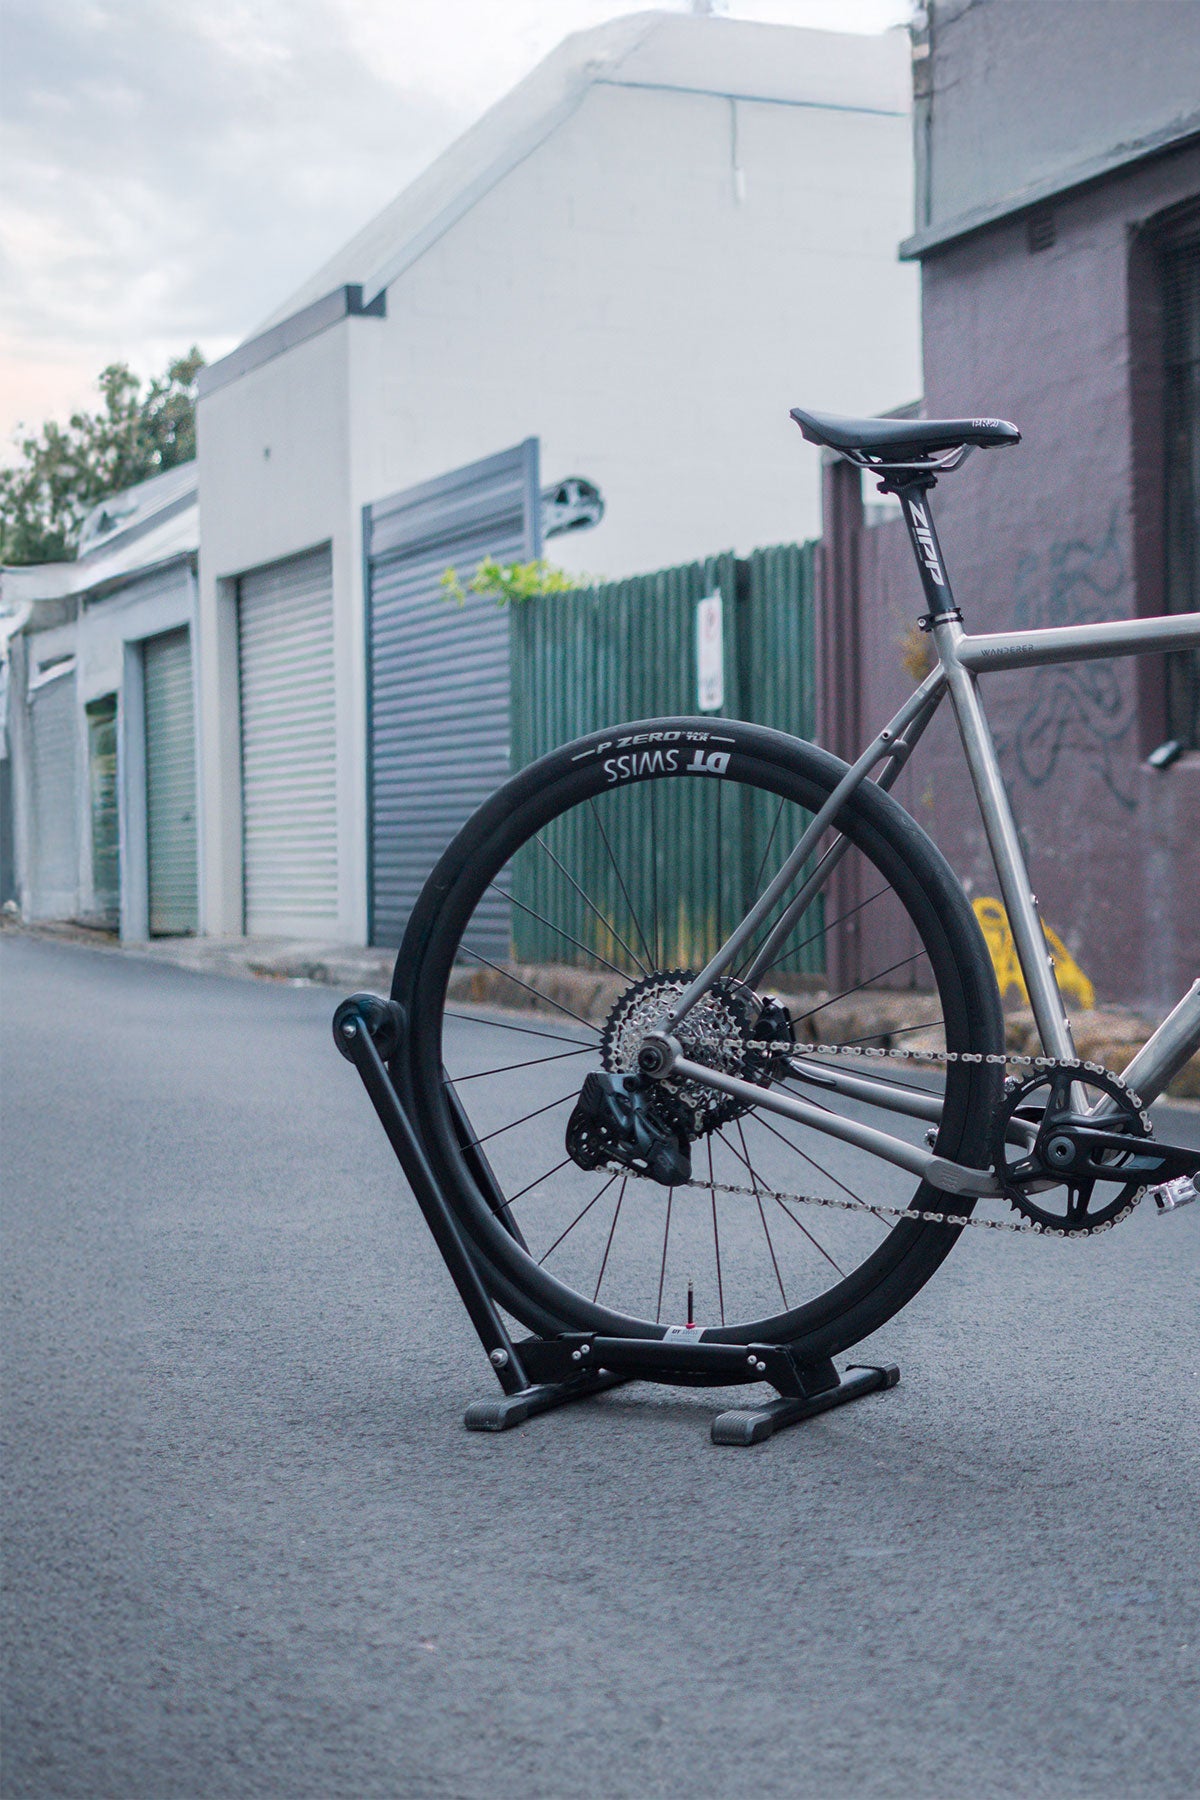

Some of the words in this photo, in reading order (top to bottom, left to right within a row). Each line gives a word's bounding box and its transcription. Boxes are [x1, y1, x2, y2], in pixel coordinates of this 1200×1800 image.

[908, 500, 945, 586] ZIPP
[980, 644, 1034, 657] WANDERER
[596, 741, 612, 754] P
[616, 731, 681, 748] ZERO
[603, 749, 680, 782] SWISS
[686, 749, 731, 774] DT
